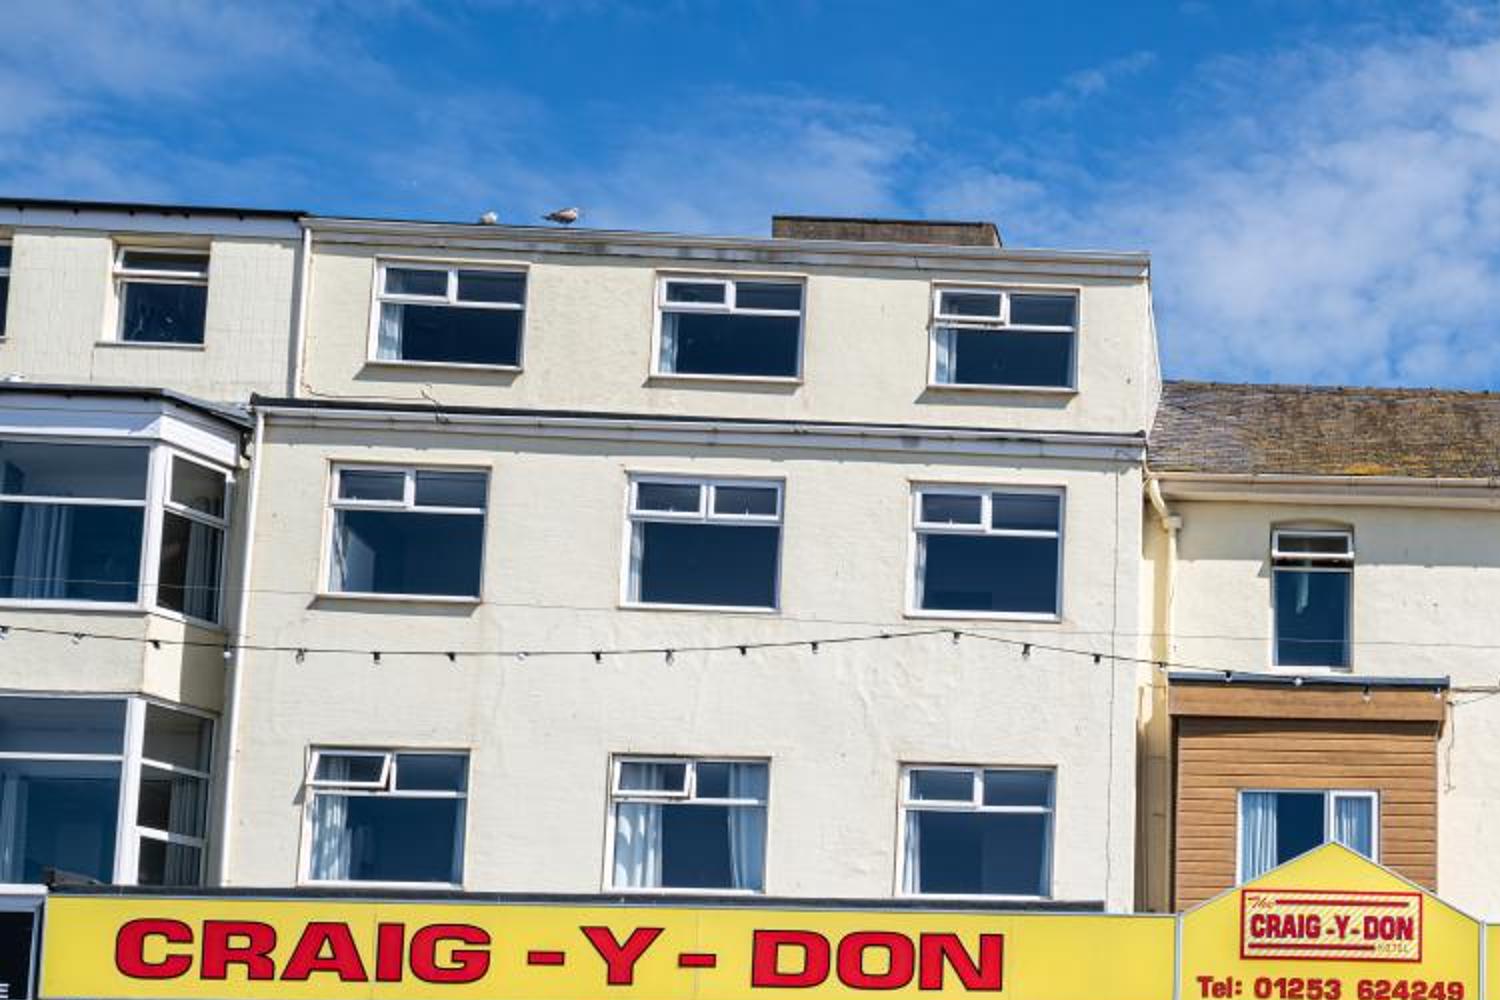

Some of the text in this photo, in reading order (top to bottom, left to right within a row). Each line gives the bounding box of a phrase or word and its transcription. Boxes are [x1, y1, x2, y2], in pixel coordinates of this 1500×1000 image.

[1250, 913, 1322, 939] CRAIG
[1363, 915, 1414, 941] DON
[115, 917, 492, 985] CRAIG
[750, 928, 1005, 993] DON
[1196, 975, 1243, 999] Tel:
[1254, 976, 1342, 1000] 01253
